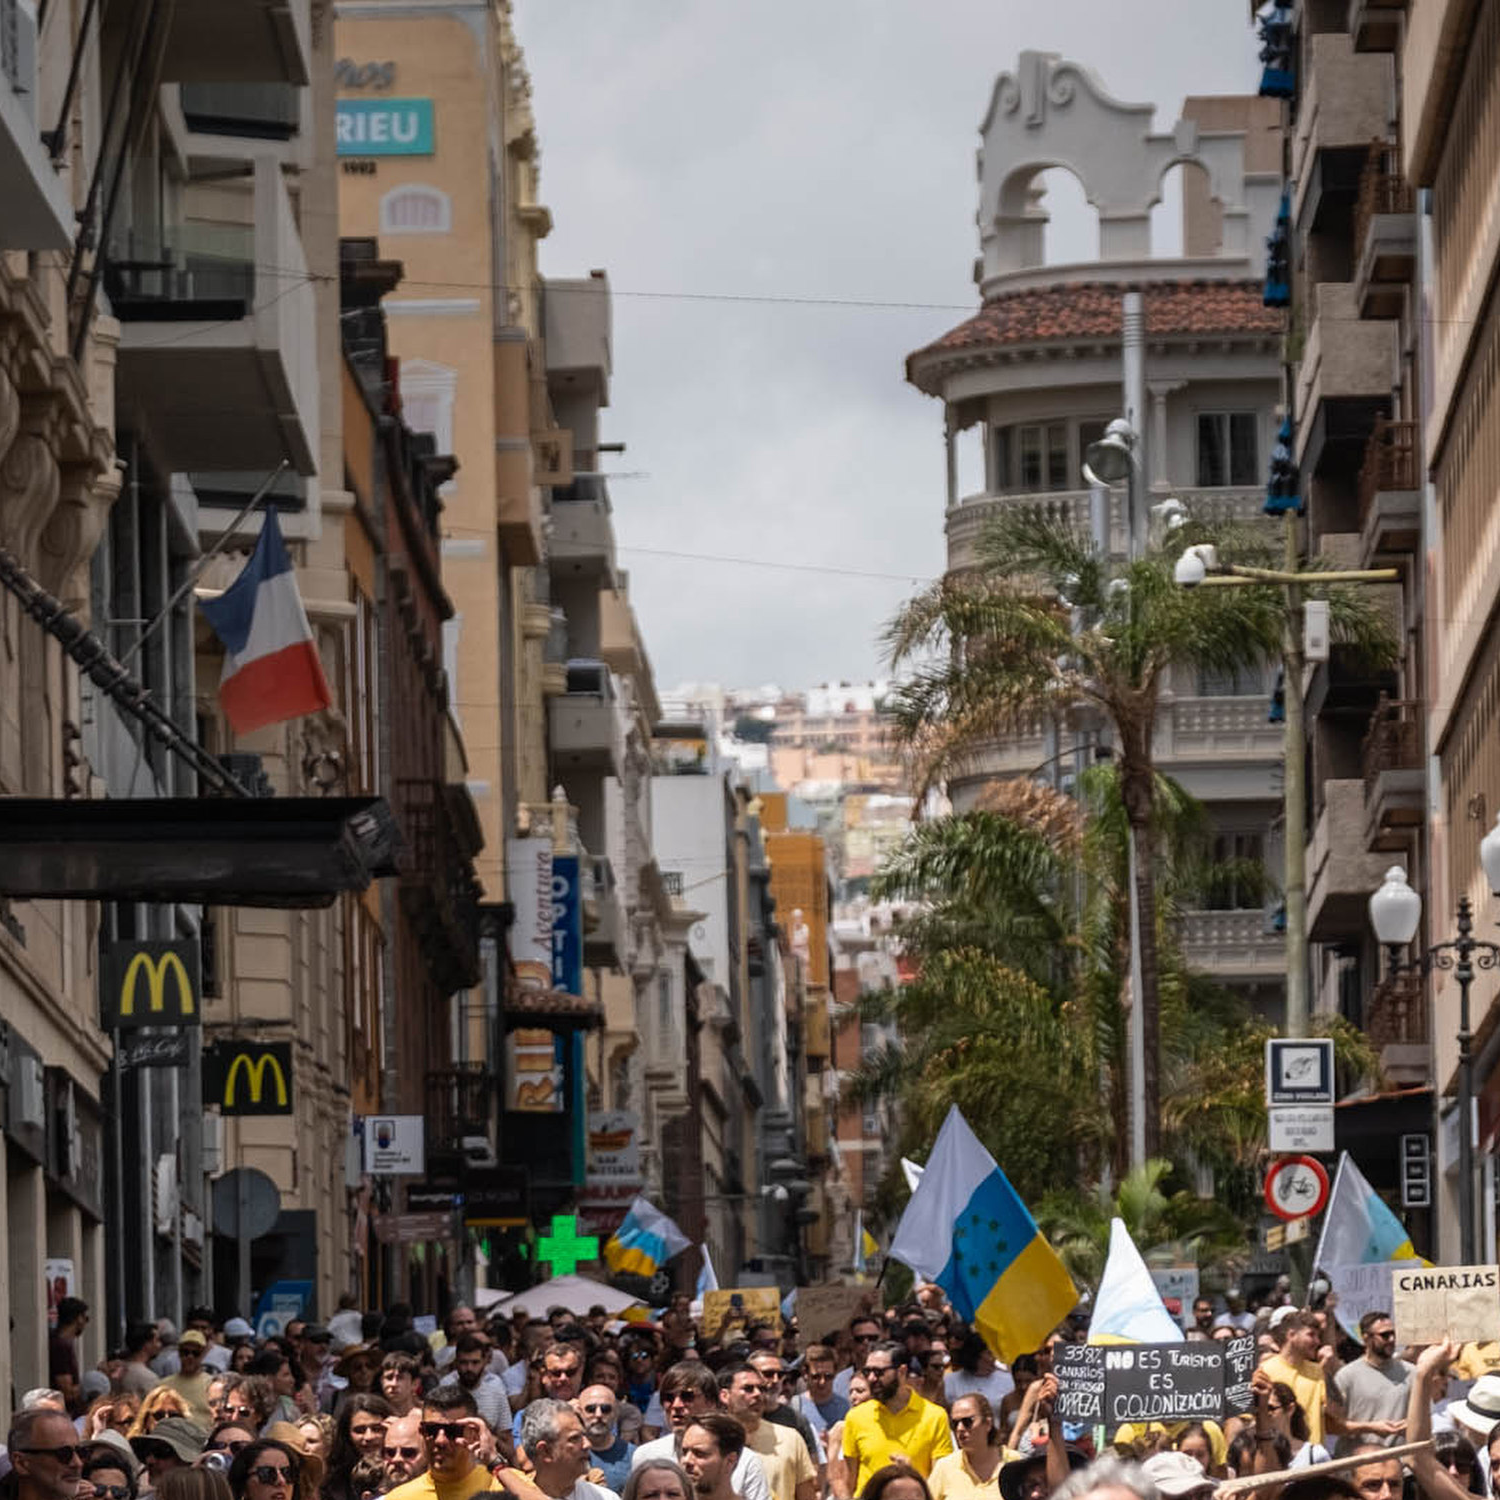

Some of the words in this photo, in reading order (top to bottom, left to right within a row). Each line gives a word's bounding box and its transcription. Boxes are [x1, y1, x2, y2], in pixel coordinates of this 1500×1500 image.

[336, 112, 419, 144] RIEU
[1400, 1272, 1496, 1292] CANARIAS
[1106, 1351, 1134, 1370] NO
[1138, 1350, 1161, 1369] ES
[1150, 1373, 1175, 1390] ES
